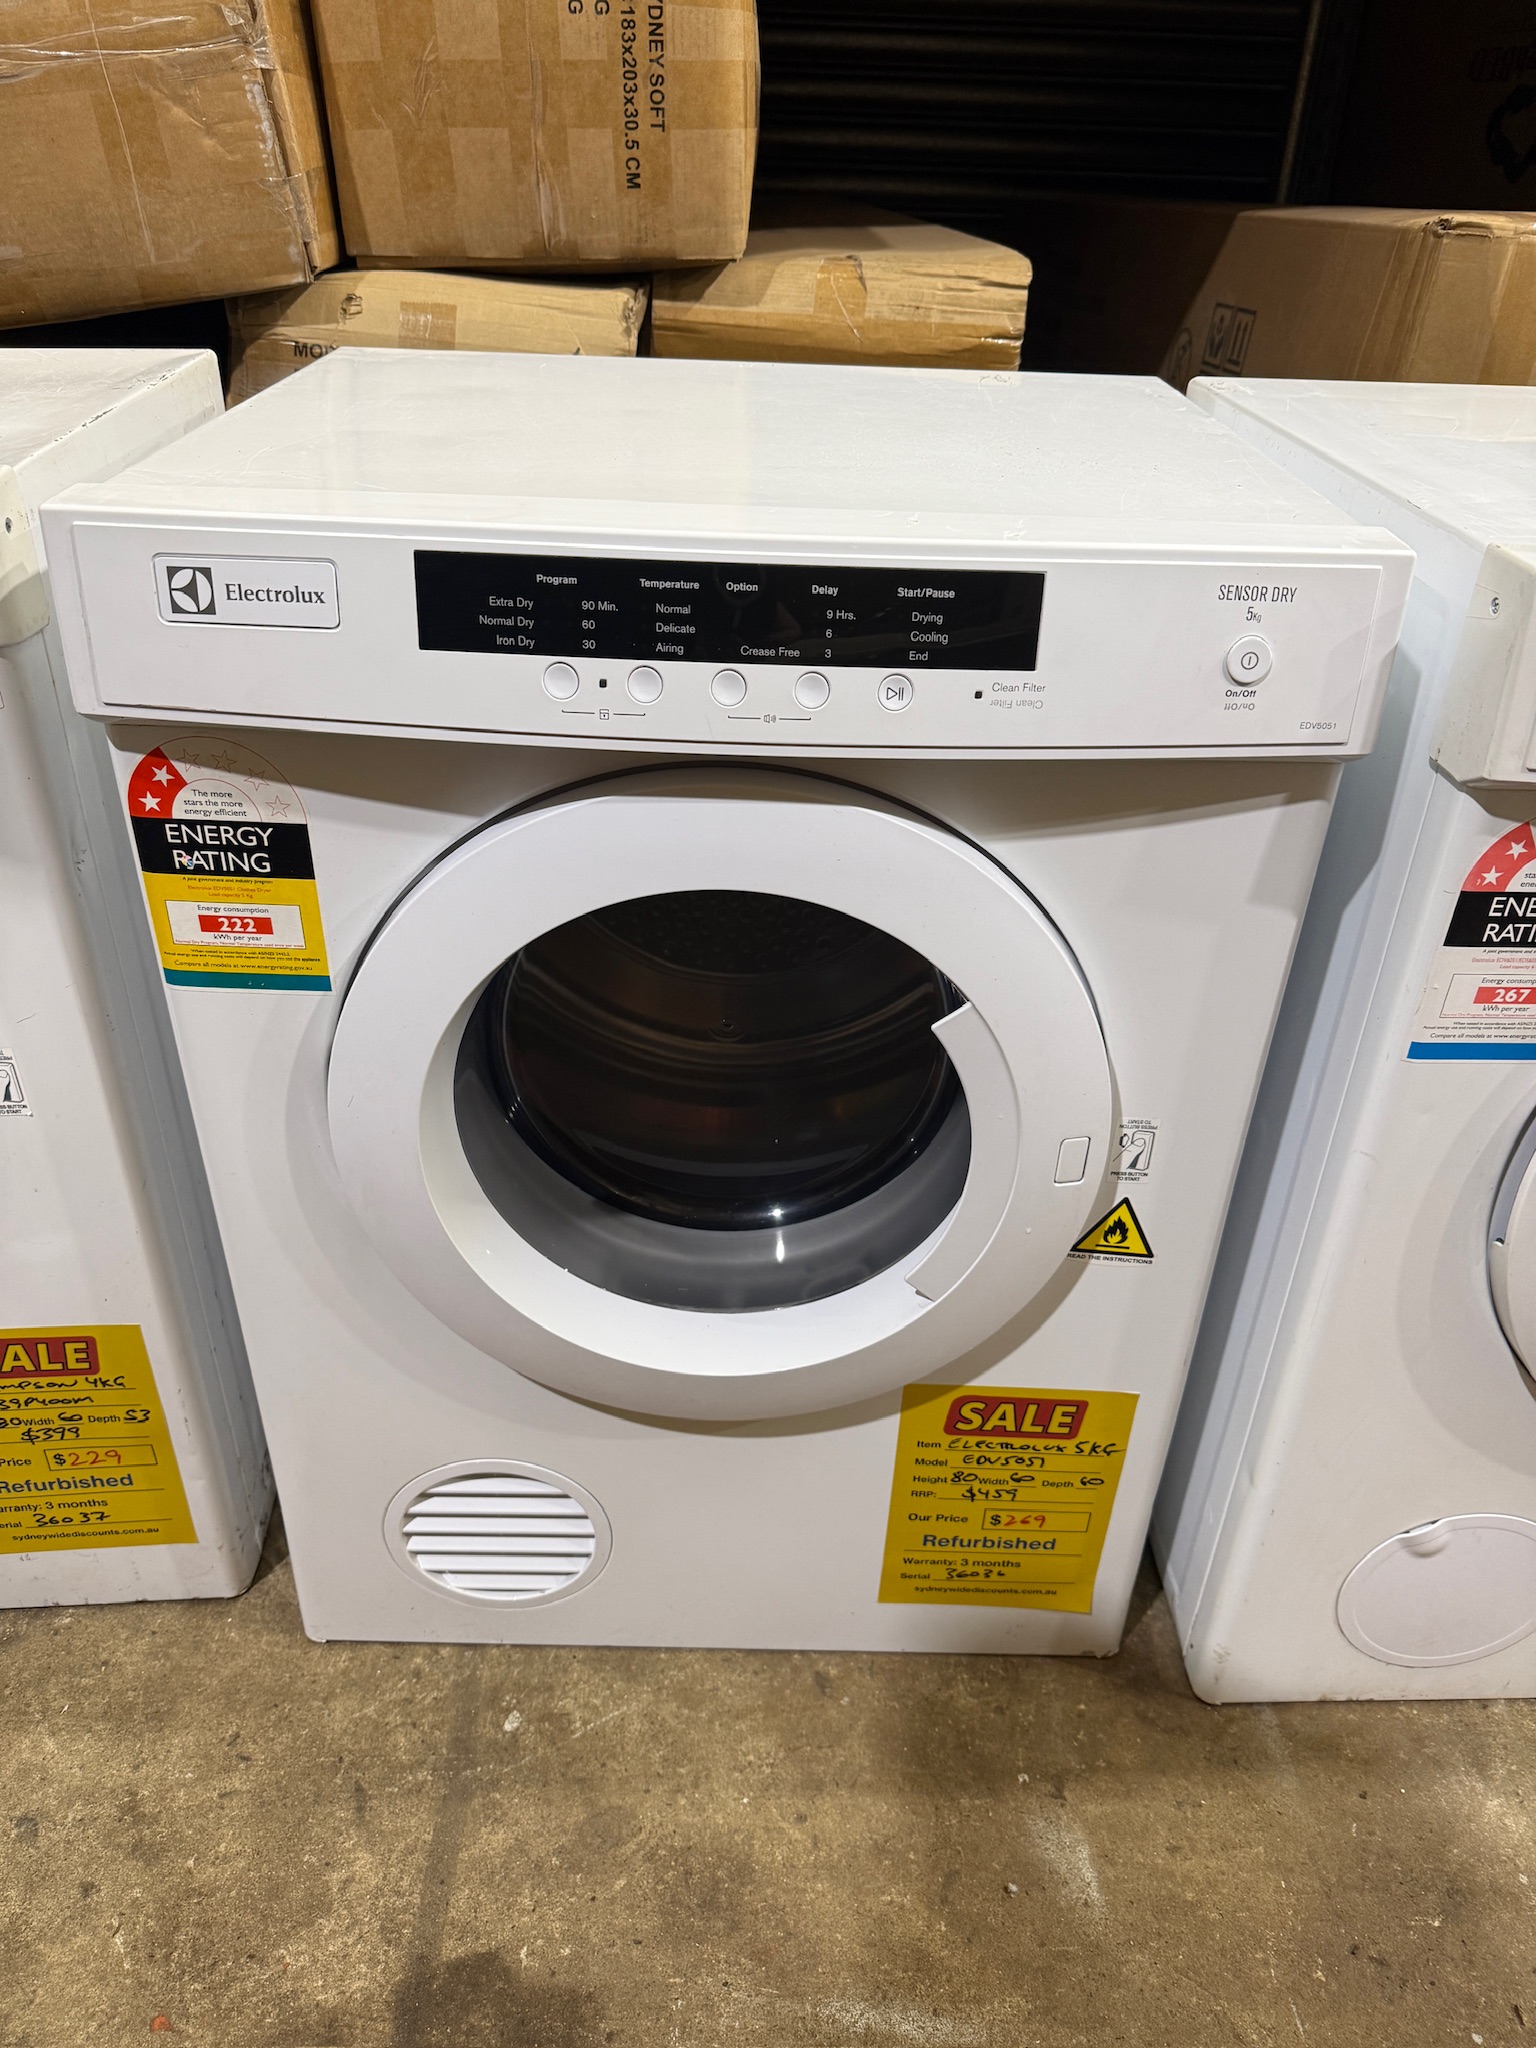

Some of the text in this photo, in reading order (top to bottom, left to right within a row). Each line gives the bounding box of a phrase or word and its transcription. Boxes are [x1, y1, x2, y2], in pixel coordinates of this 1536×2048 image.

[648, 0, 665, 132] DNEY SOFT
[626, 158, 641, 189] CM
[536, 574, 578, 586] Program
[639, 578, 700, 591] Temperature
[225, 583, 326, 604] Electrolux
[726, 582, 759, 594] Option
[811, 585, 839, 596] Delay
[897, 587, 956, 598] Start/Pause
[1218, 584, 1298, 602] SENSOR DRY
[489, 596, 534, 610] Extra Dry
[581, 600, 619, 611] 90 Min.
[655, 604, 691, 614] Normal
[826, 610, 856, 620] 9 Hrs.
[911, 612, 943, 624] Drying
[479, 615, 535, 629] Normal Dry
[582, 620, 596, 630] 60
[655, 622, 696, 634] Delicate
[825, 629, 832, 639] 6
[910, 631, 949, 644] Cooling
[496, 635, 535, 649] Iron Dry
[582, 640, 596, 650] 30
[655, 642, 684, 655] Airing
[740, 646, 801, 657] Crease Free
[825, 649, 832, 659] 3
[908, 651, 929, 661] End
[992, 682, 1046, 692] Clean Filter
[1225, 690, 1257, 698] On/Off
[1299, 722, 1337, 730] EDV5051
[191, 789, 208, 797] The
[184, 809, 213, 817] energy
[164, 823, 274, 846] ENERGY
[172, 849, 272, 873] RATING
[197, 905, 221, 913] Energy
[1488, 897, 1536, 917] ENE
[217, 918, 257, 932] 222
[1482, 923, 1536, 942] RATI
[1492, 988, 1531, 1002] 267
[1102, 1256, 1153, 1264] INSTRUCTIONS
[0, 1342, 91, 1373] ALE
[22, 1418, 55, 1426] Width
[88, 1415, 121, 1423] Depth
[953, 1400, 1079, 1434] SALE
[917, 1440, 942, 1449] Item
[0, 1458, 32, 1467] Price
[914, 1454, 1045, 1468] Model EDV5051
[0, 1474, 134, 1494] Refurbished
[912, 1475, 948, 1484] Height
[950, 1471, 978, 1483] 80
[1041, 1480, 1074, 1488] Depth
[911, 1490, 937, 1498] RRP:
[0, 1504, 43, 1513] arranty:
[58, 1499, 108, 1508] months
[908, 1513, 932, 1522] Our
[936, 1514, 968, 1523] Price
[12, 1527, 159, 1541] sydneywidediscounts.com.au
[922, 1534, 1057, 1550] Refurbished
[903, 1558, 958, 1566] Warranty:
[972, 1559, 1021, 1568] months
[914, 1586, 1057, 1595] sydneywidediscounts.com.au
